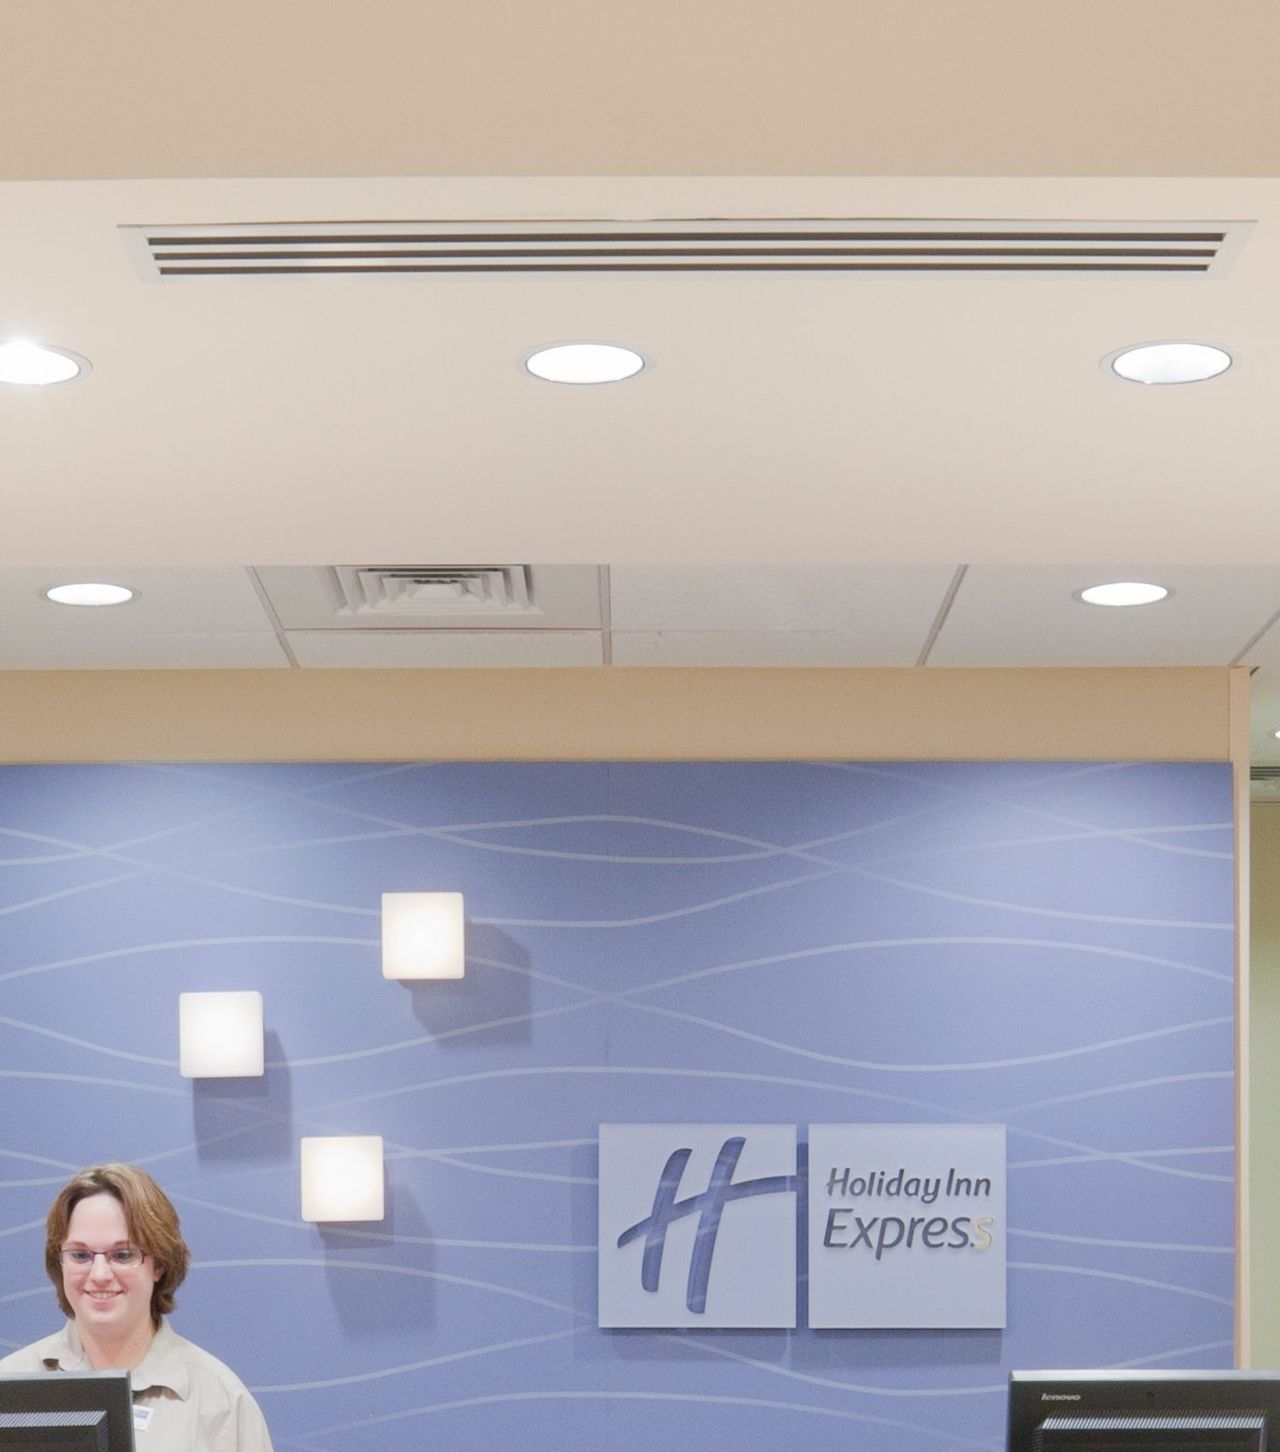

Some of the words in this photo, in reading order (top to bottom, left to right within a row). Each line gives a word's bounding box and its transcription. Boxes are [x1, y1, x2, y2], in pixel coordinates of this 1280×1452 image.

[826, 1167, 940, 1204] Holiday
[945, 1168, 991, 1197] Inn
[823, 1208, 994, 1261] Express
